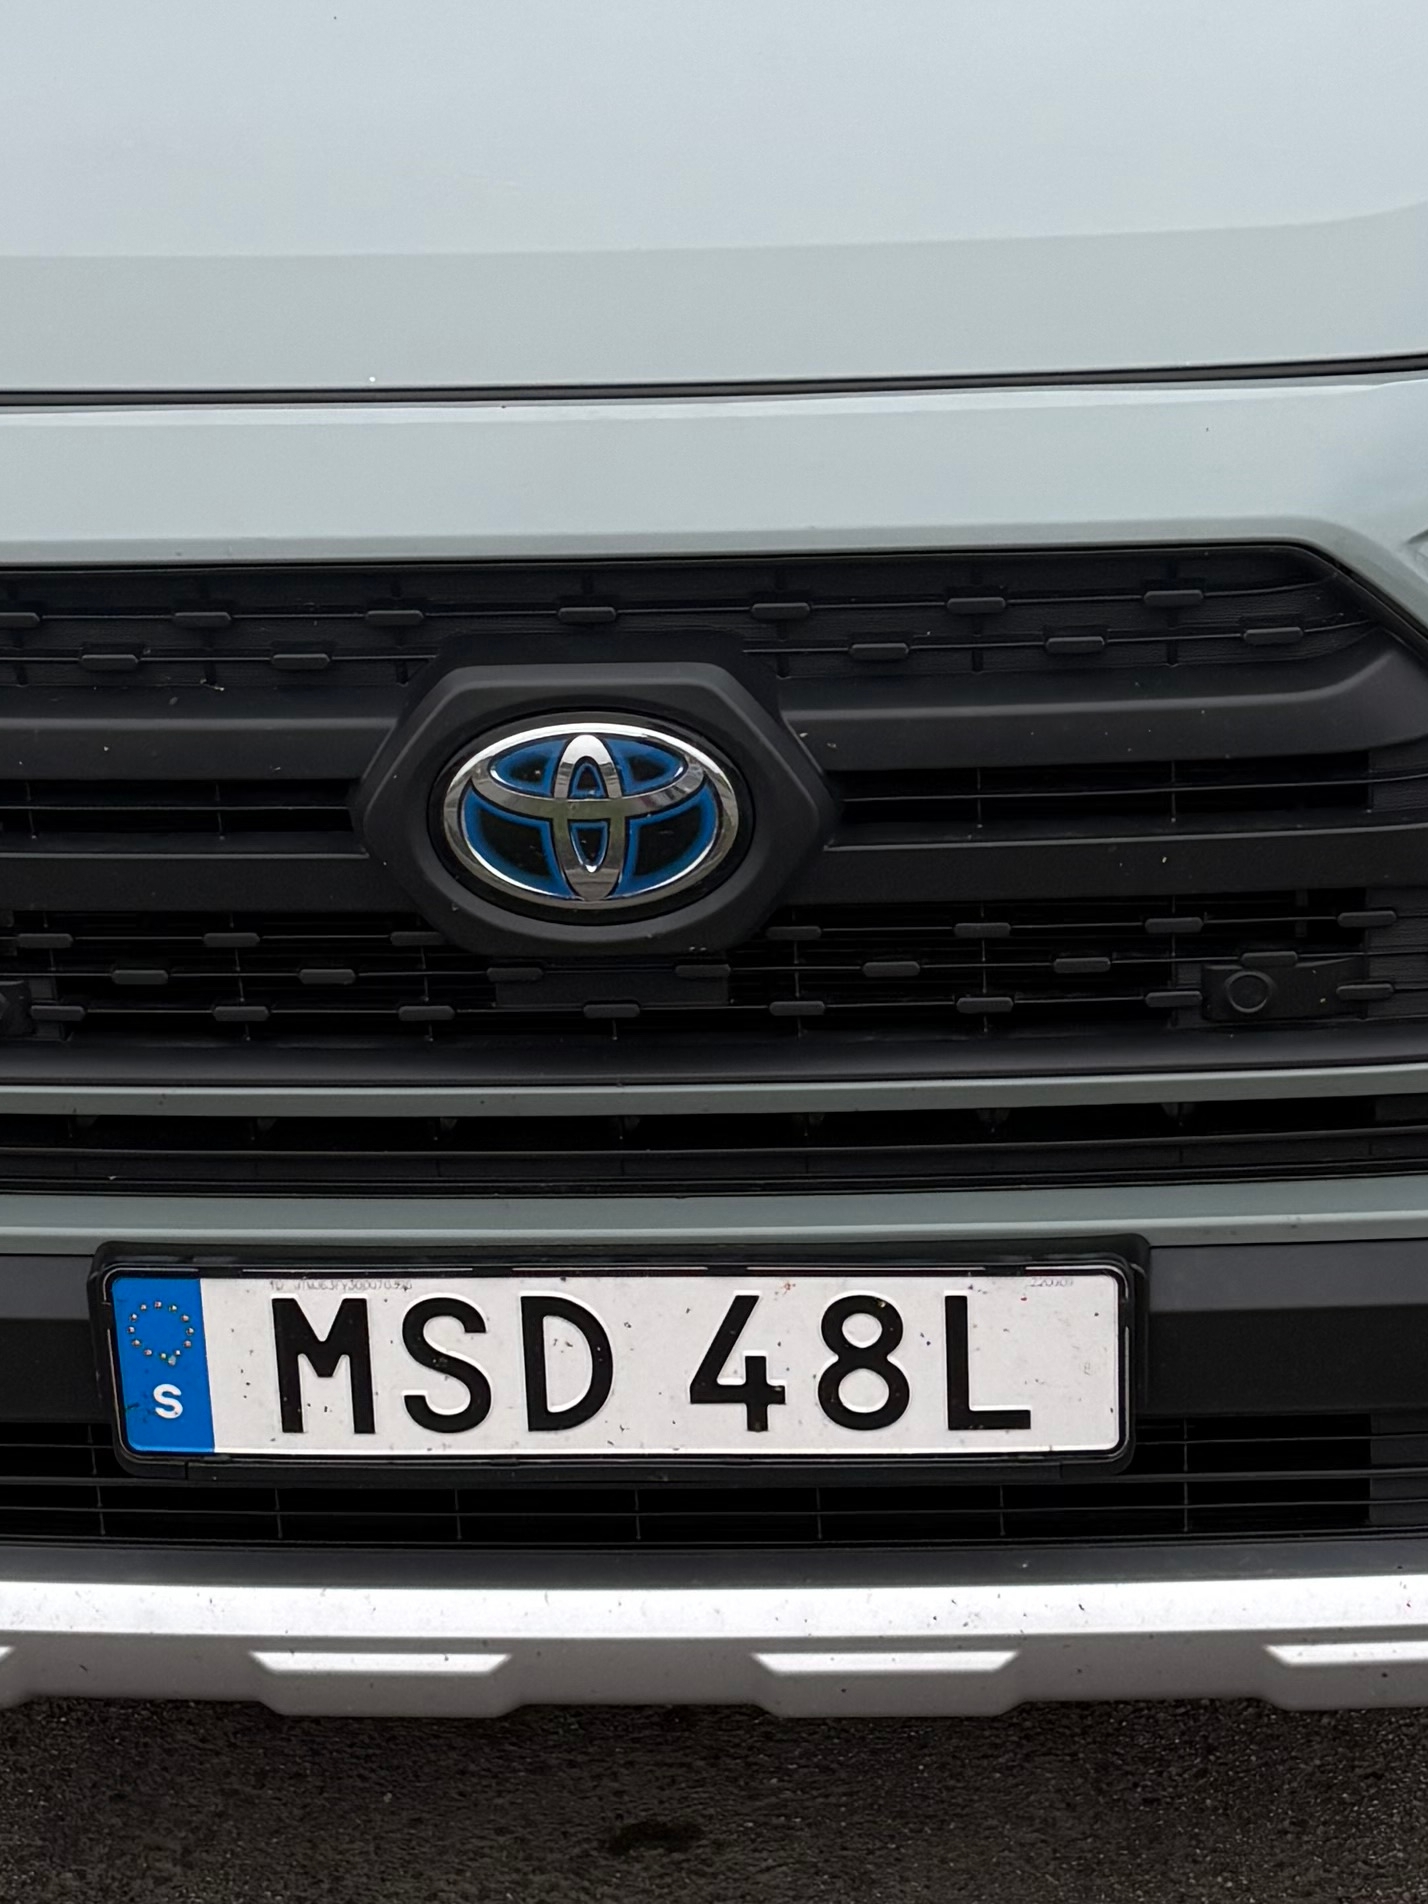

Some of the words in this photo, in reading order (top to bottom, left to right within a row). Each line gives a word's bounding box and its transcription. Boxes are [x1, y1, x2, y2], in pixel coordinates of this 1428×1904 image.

[152, 1382, 184, 1420] S
[271, 1294, 614, 1434] MSD
[689, 1292, 1032, 1432] 48L
